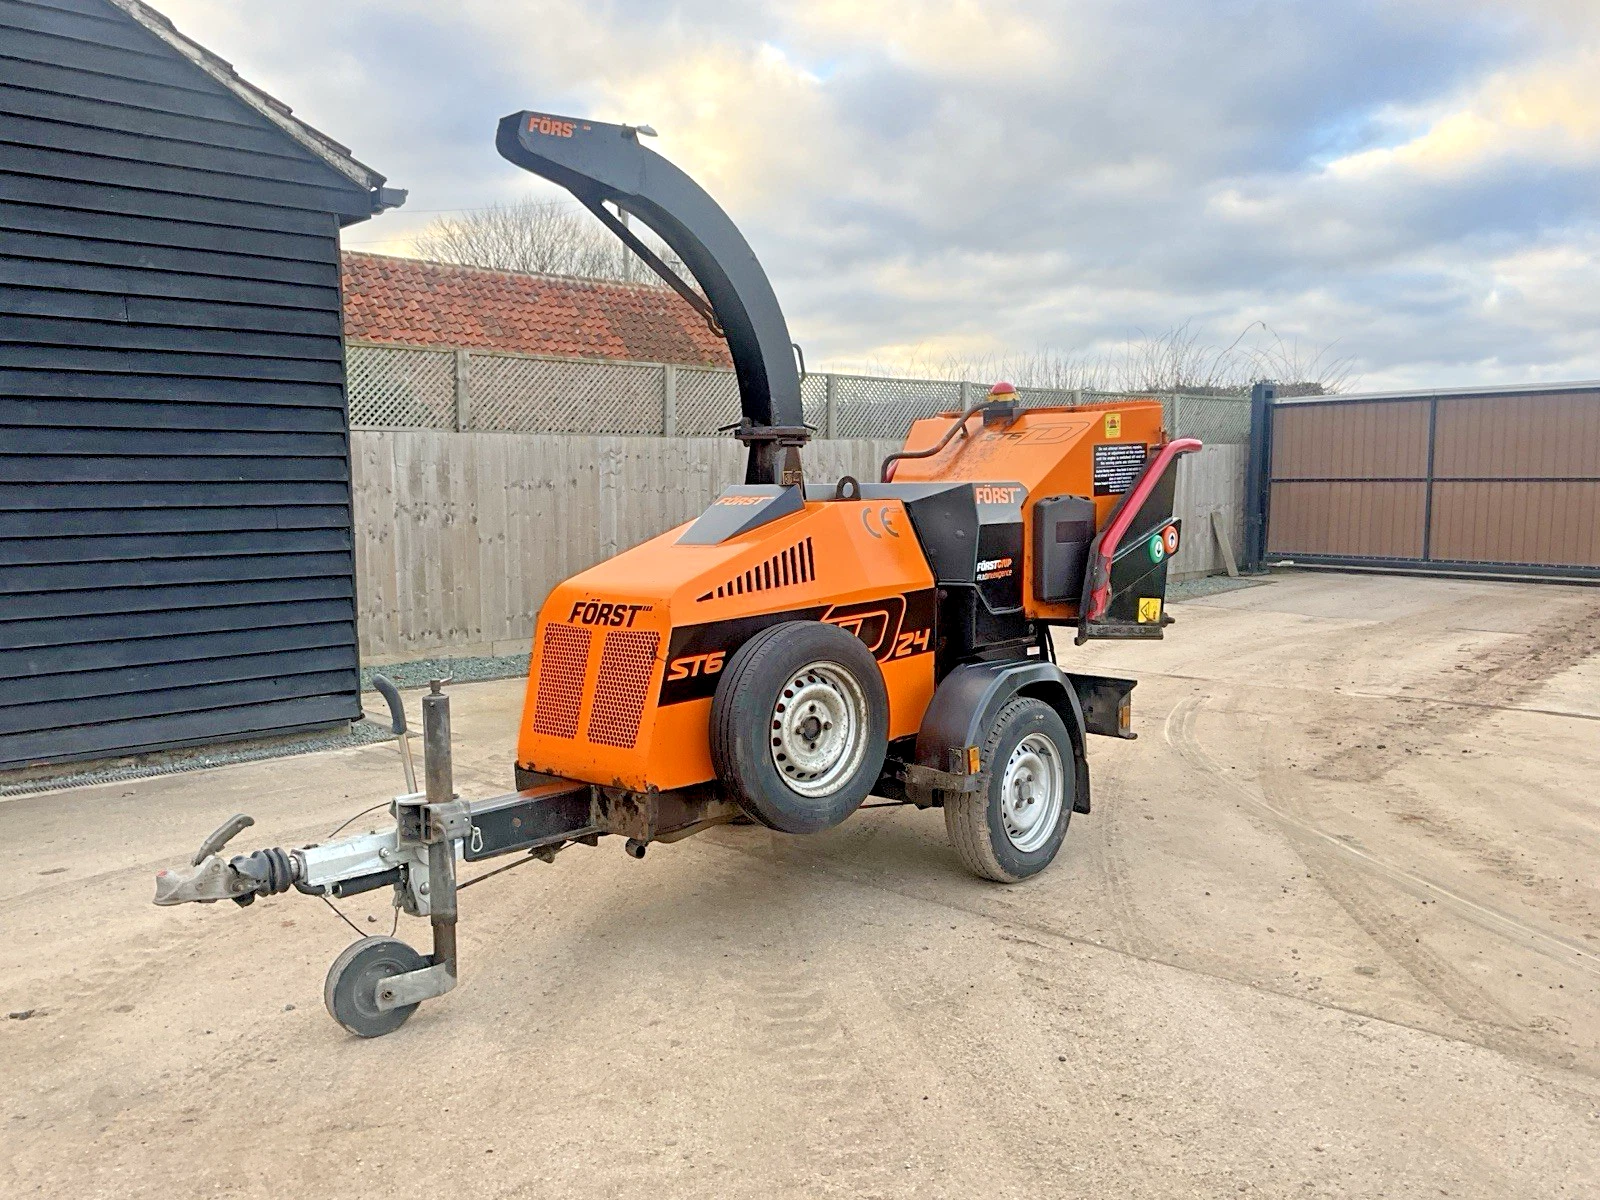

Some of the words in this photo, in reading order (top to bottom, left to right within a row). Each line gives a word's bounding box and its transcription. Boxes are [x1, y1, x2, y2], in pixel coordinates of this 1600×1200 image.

[528, 117, 576, 138] FÖRS
[714, 495, 772, 506] FÖRST
[975, 484, 1017, 504] FÖRST
[567, 599, 646, 628] FÖRST
[895, 628, 931, 657] 24
[667, 651, 726, 681] ST6
